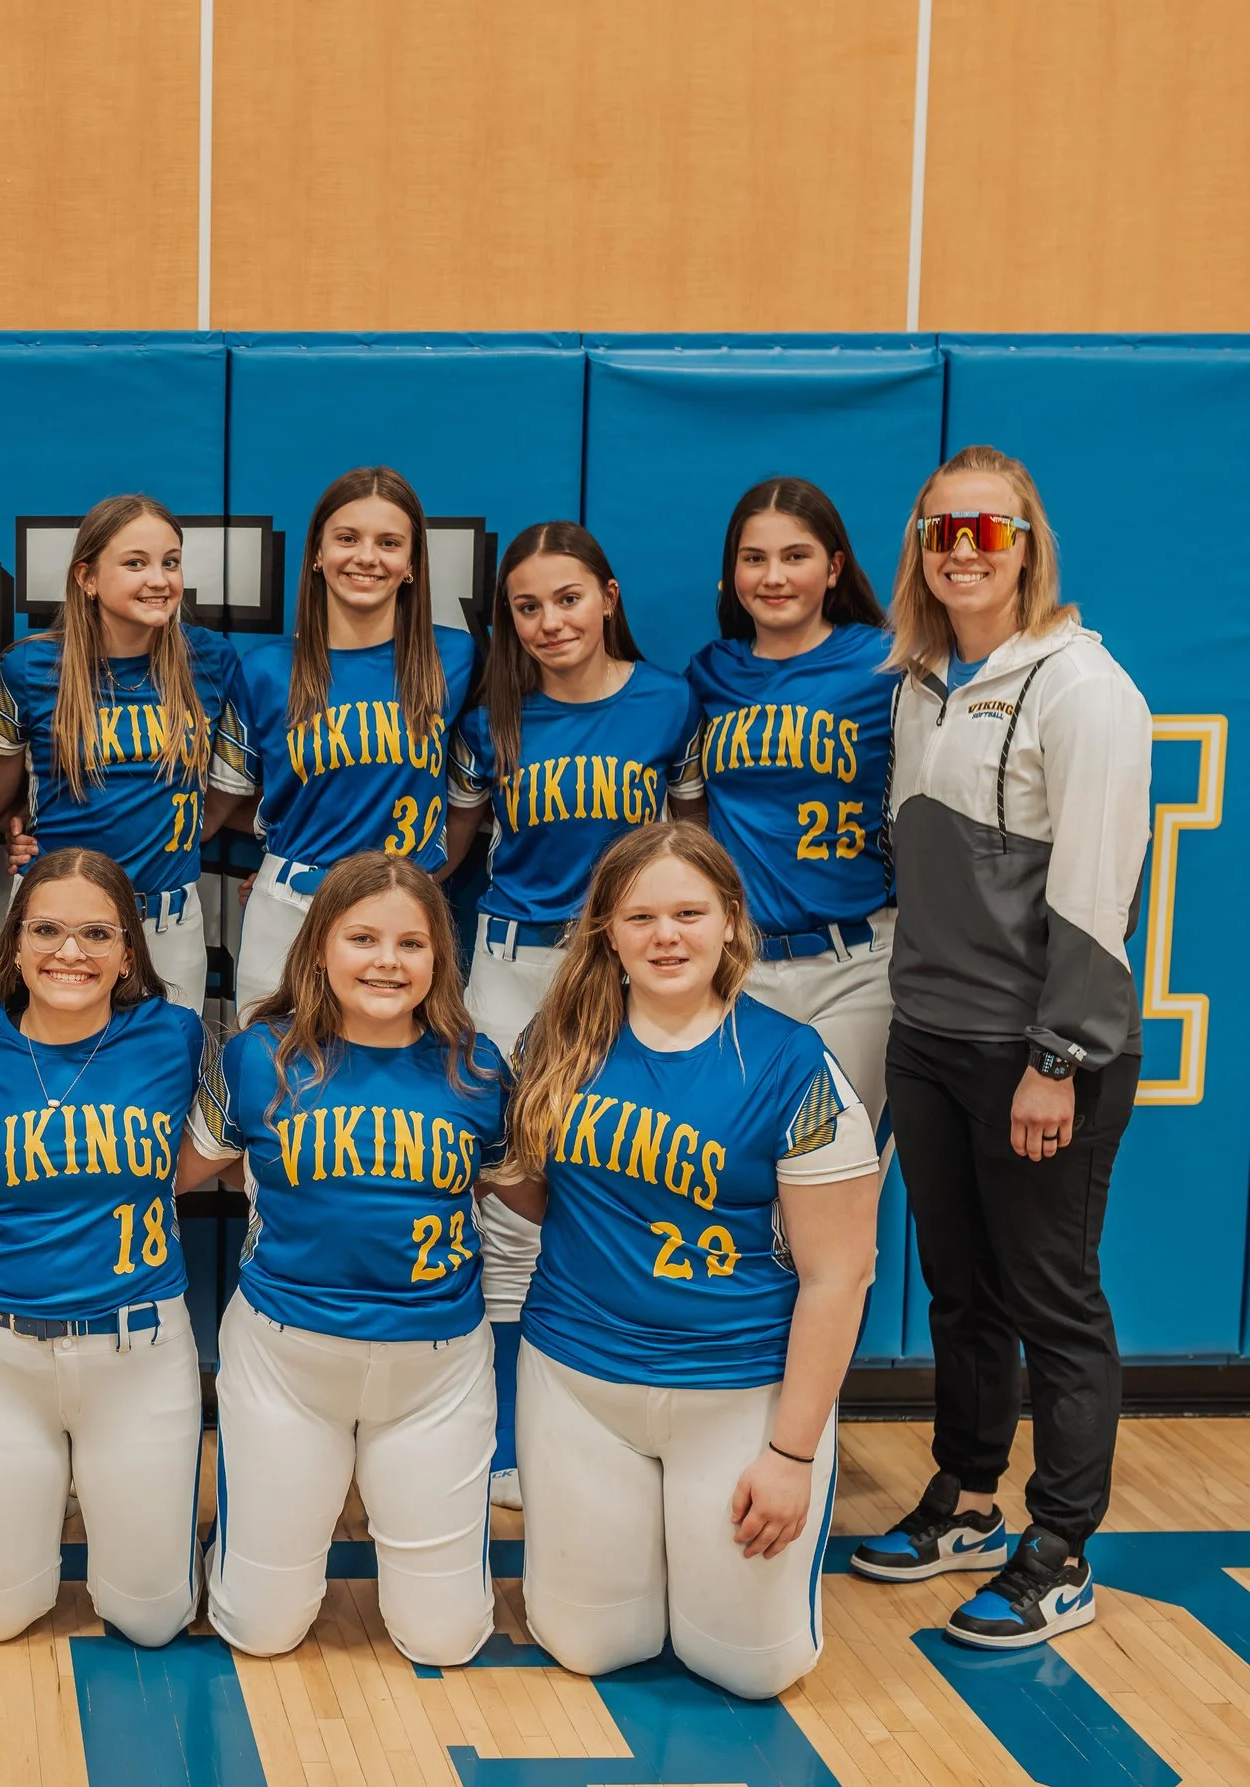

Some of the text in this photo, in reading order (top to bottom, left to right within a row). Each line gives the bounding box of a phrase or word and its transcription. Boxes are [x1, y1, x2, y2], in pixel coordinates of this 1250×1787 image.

[702, 704, 860, 783] VIKINGS
[502, 755, 659, 833] VIKINGS
[797, 801, 866, 860] 25
[277, 1105, 476, 1195] VIKINGS
[544, 1093, 726, 1211] IKINGS
[113, 1197, 168, 1275] 18
